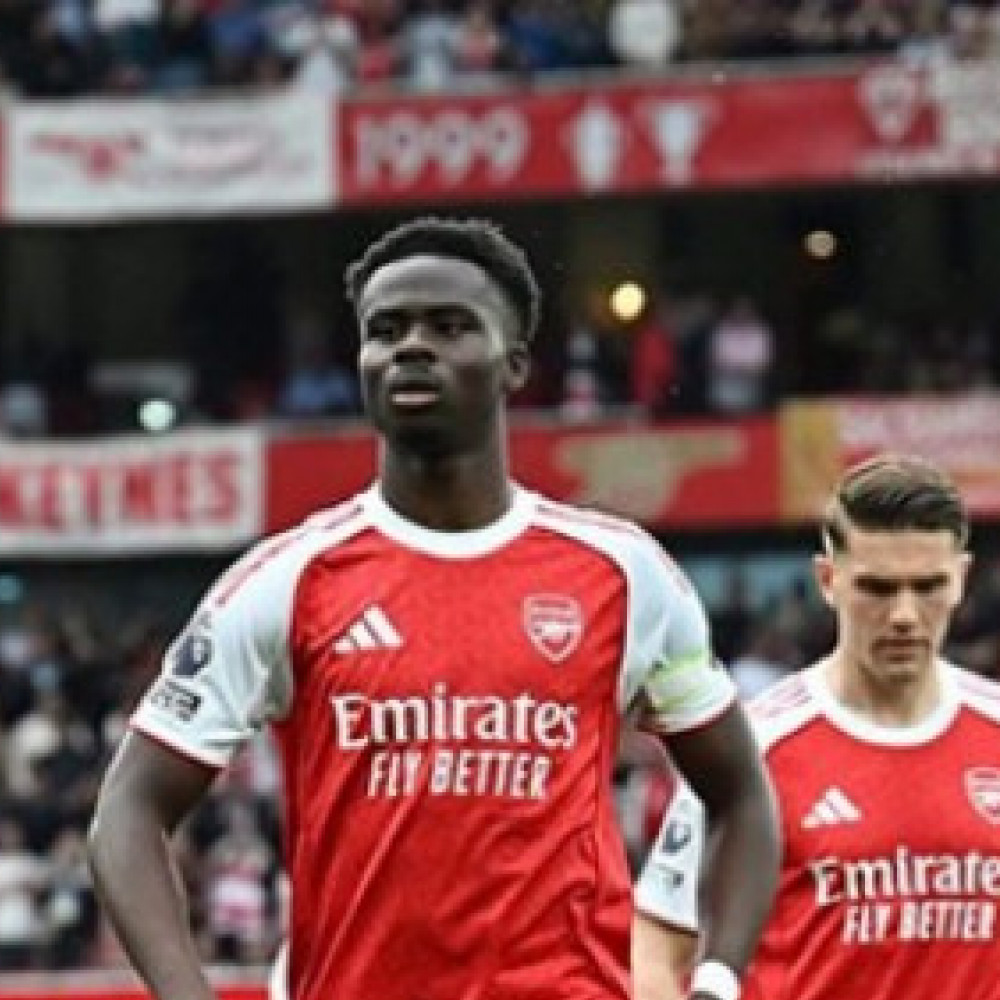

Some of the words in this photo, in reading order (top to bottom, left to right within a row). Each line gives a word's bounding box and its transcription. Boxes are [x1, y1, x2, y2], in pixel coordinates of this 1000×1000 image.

[354, 110, 530, 186] 1999
[332, 683, 578, 749] Emirates
[368, 751, 423, 797] FLY
[430, 750, 551, 798] BETTER
[841, 903, 891, 945] FLY
[898, 900, 997, 941] BETTER
